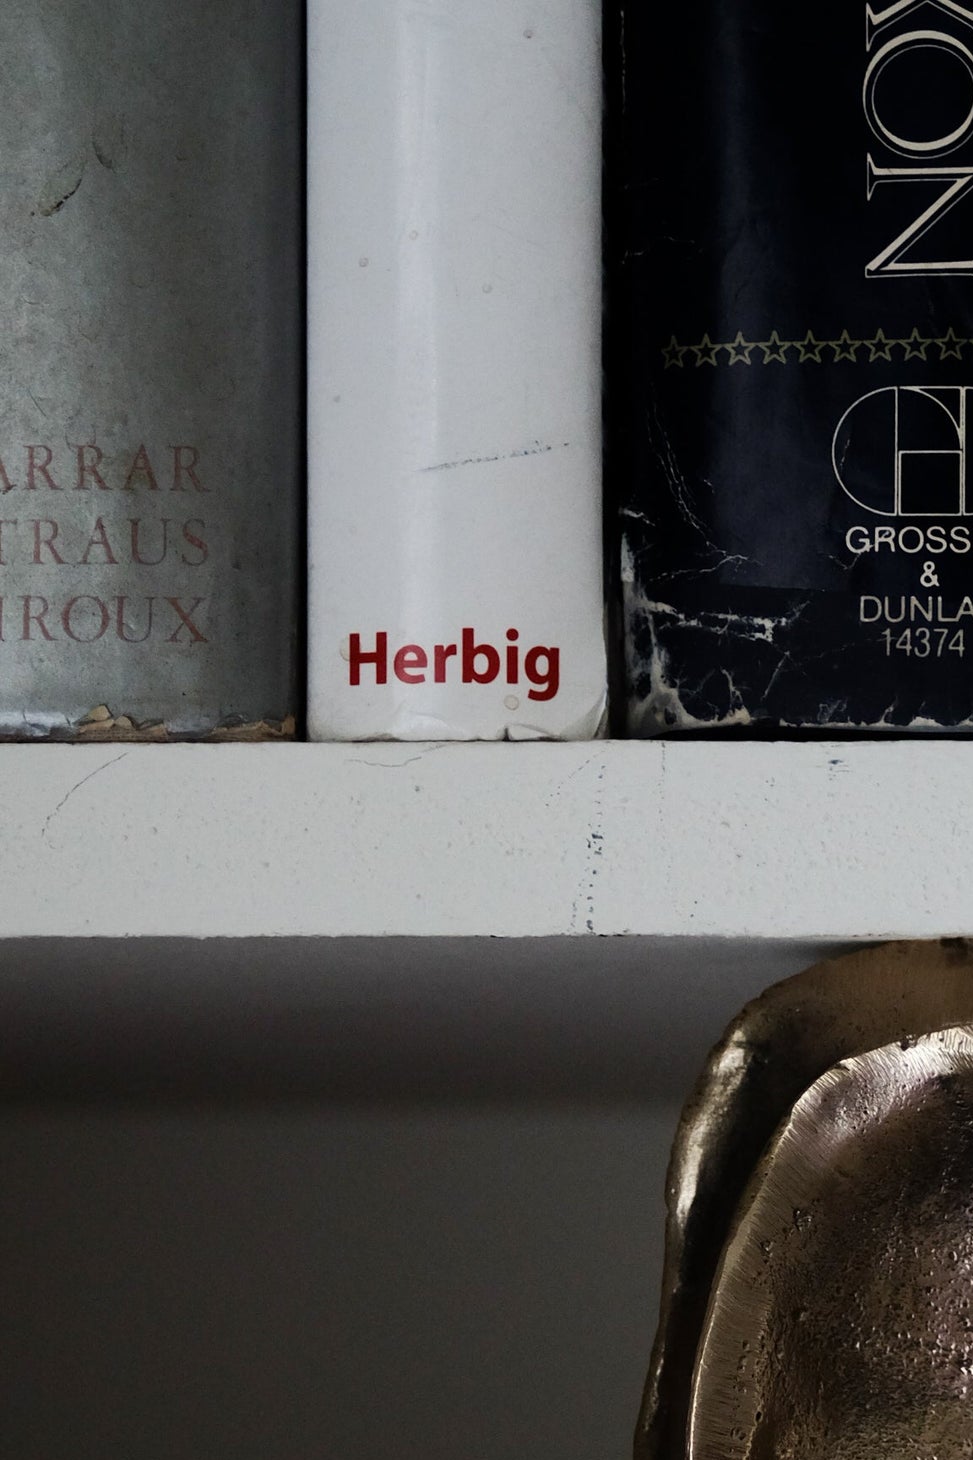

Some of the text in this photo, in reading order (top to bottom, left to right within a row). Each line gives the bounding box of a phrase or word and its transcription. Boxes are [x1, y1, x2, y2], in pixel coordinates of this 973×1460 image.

[919, 560, 940, 588] &
[880, 628, 966, 658] 14374
[348, 627, 560, 702] Herbig
